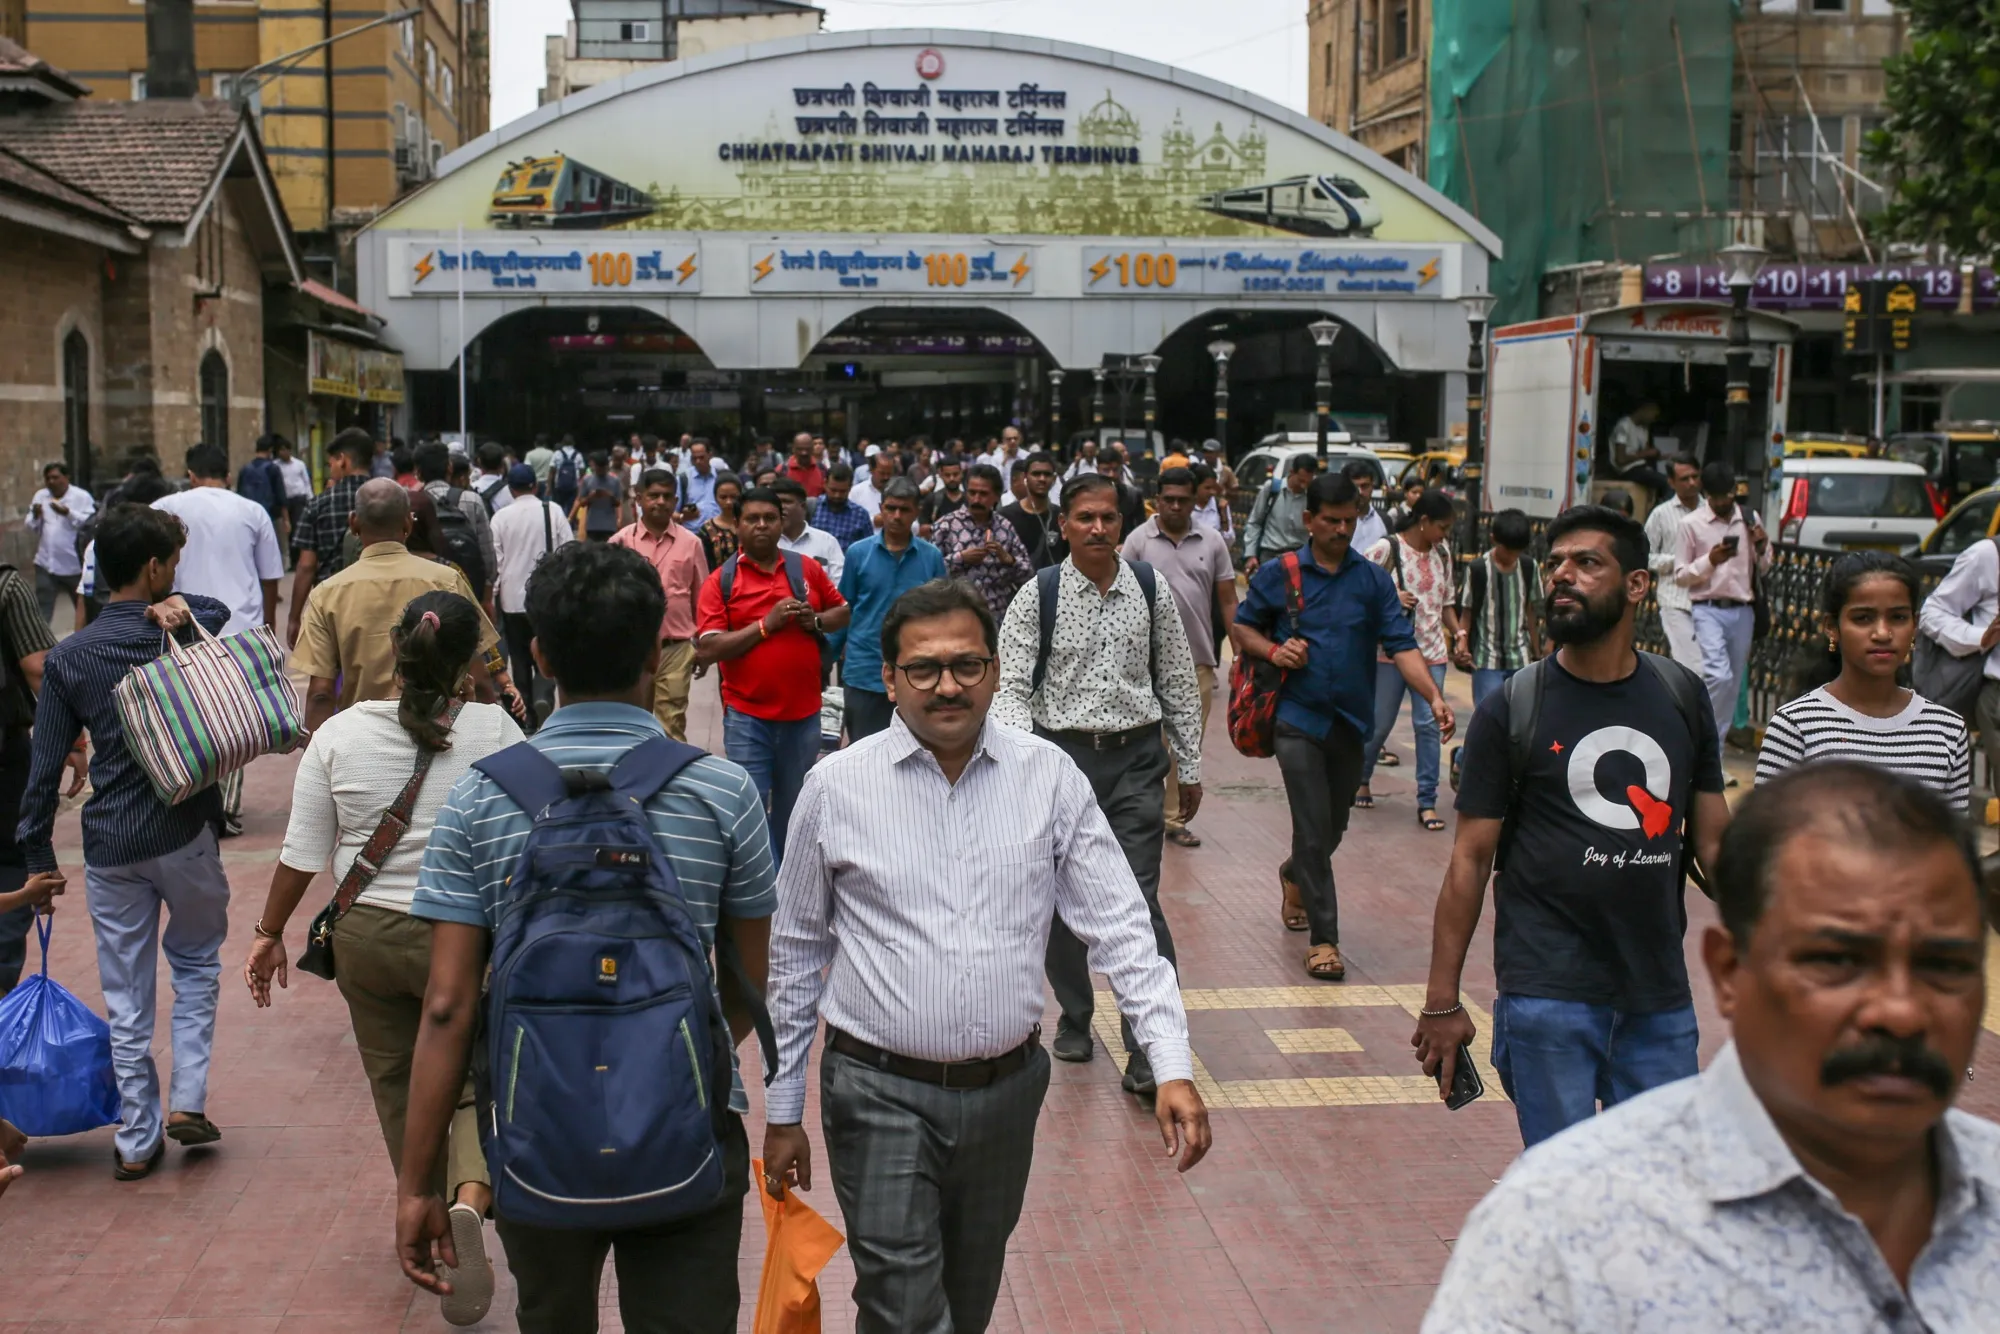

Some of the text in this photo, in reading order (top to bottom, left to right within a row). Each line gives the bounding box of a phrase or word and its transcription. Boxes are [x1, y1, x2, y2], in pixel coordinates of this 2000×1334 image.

[792, 81, 1066, 112] छत्रपती शिवाजी महाराज टर्मिनस
[794, 109, 1064, 140] छत्रपति शिवाजी महाराज टर्मिनस
[718, 143, 1140, 165] CHHATRAPATI SHIVAJI MAHARAJ TERMINUS
[587, 252, 632, 286] 100
[924, 252, 968, 287] 100
[1114, 252, 1176, 287] 100
[1665, 269, 1682, 295] 8
[1767, 269, 1798, 295] 10
[1820, 269, 1848, 295] 11
[1923, 269, 1953, 295] 13
[1583, 846, 1672, 869] Joy of Learning
